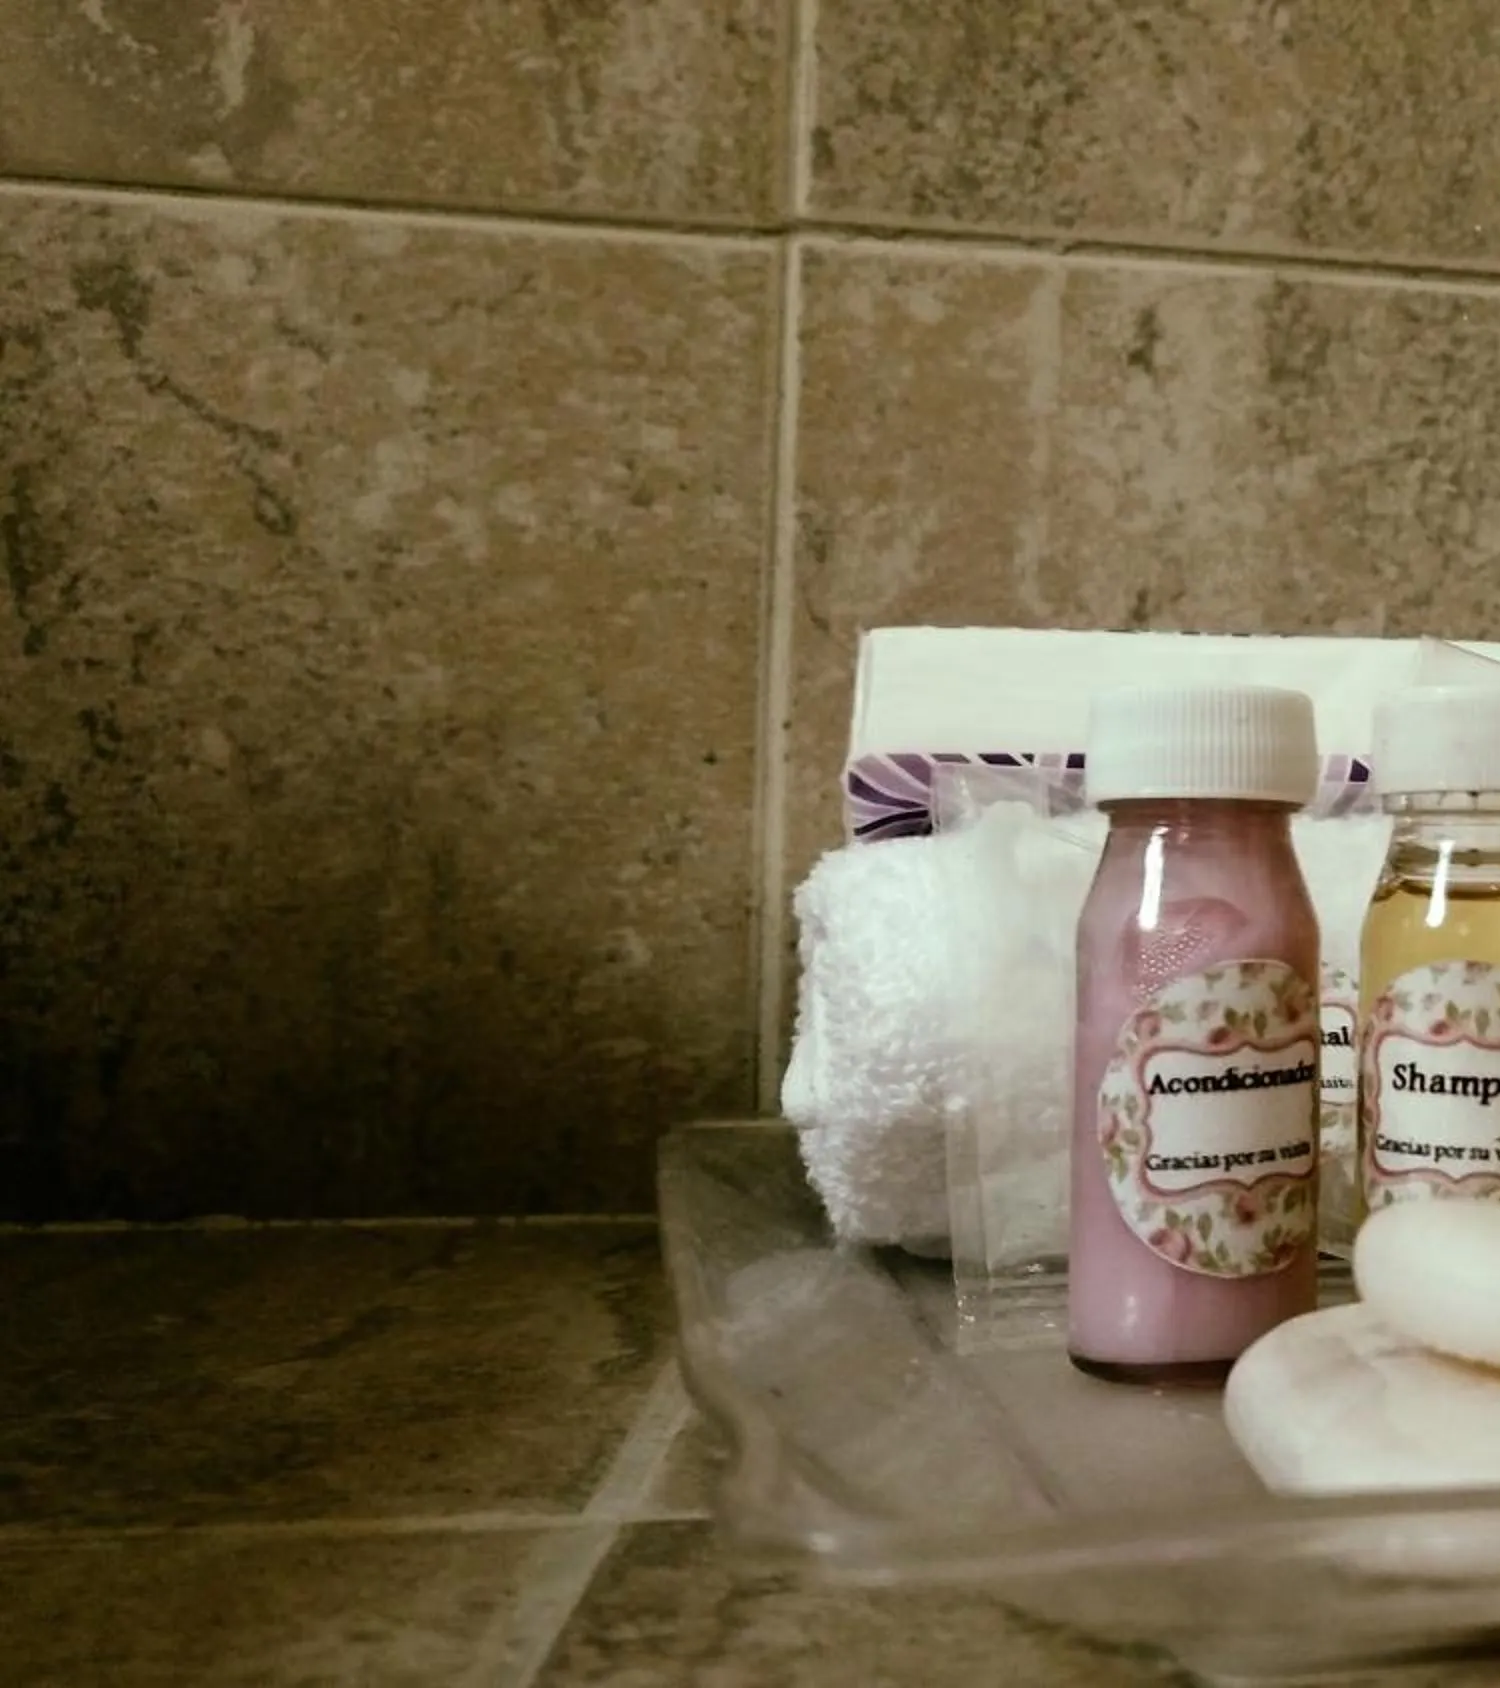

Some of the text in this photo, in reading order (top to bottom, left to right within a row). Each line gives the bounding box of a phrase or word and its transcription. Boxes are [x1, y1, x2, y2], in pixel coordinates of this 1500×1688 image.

[1375, 1133, 1431, 1156] Gracias
[1433, 1145, 1466, 1163] por
[1468, 1147, 1490, 1161] su
[1146, 1151, 1219, 1171] Gracias
[1223, 1151, 1255, 1172] por
